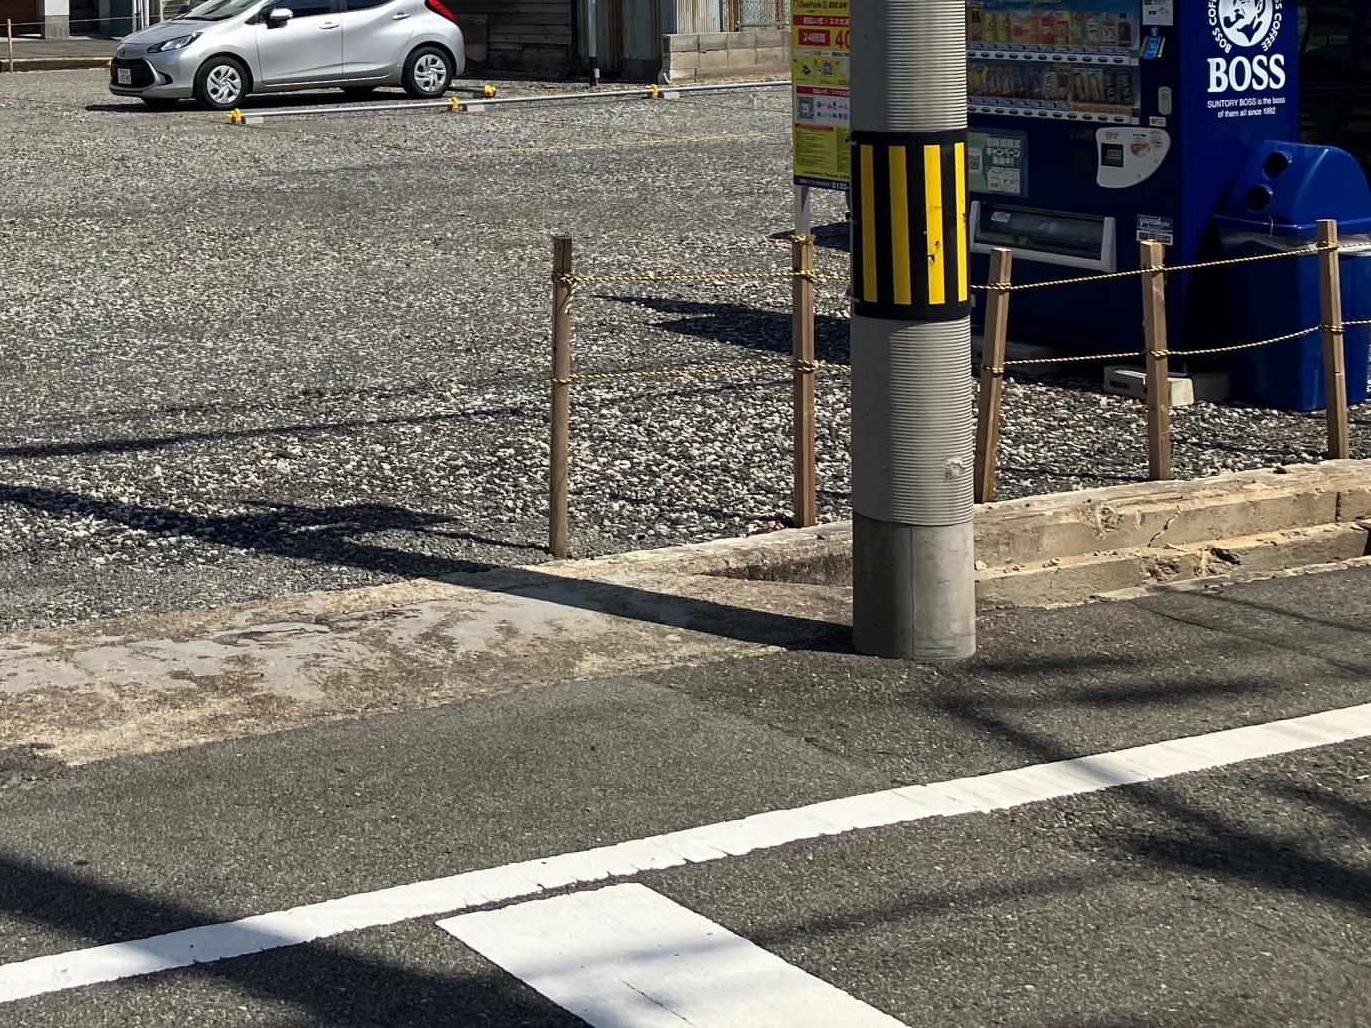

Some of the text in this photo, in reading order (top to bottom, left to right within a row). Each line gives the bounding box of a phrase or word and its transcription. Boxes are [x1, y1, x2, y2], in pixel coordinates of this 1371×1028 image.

[1212, 27, 1232, 53] BOSS
[1262, 14, 1282, 52] COFFEE
[1207, 54, 1286, 93] BOSS
[1207, 99, 1239, 108] SUNTORY
[1239, 98, 1257, 107] BOSS
[1262, 97, 1272, 105] the
[1272, 96, 1285, 104] boss
[1247, 108, 1262, 116] since
